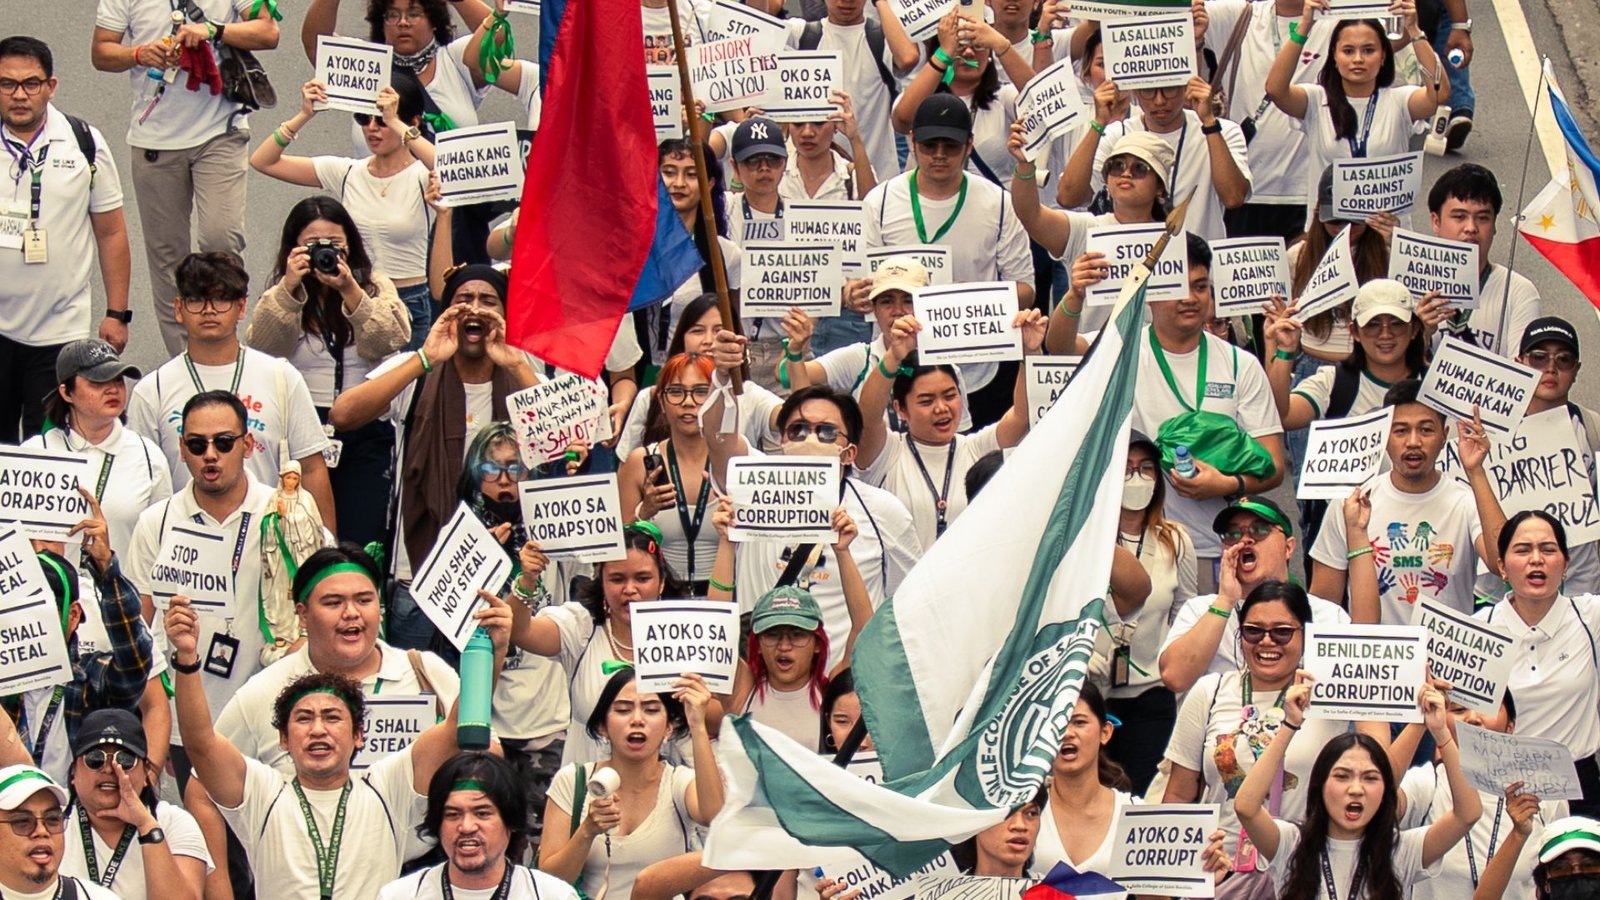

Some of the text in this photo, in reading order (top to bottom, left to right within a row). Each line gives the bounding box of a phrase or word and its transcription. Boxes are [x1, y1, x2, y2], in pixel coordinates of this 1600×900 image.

[900, 7, 926, 26] MGA
[1070, 4, 1101, 14] AKBAYAN
[1103, 8, 1127, 16] YOUTH
[1112, 26, 1184, 43] LASALLIANS
[1124, 42, 1174, 58] AGAINST
[327, 56, 381, 74] AYOKO SA
[692, 54, 778, 84] HAS ITS EYES
[1112, 56, 1189, 74] CORRUPTION
[328, 72, 379, 91] KURAKOT
[780, 68, 832, 82] OKO SA
[650, 89, 672, 101] ANG
[710, 78, 734, 102] ON
[784, 85, 830, 100] RAKOT
[1036, 81, 1066, 106] SHALL
[1037, 97, 1067, 121] STEAL
[437, 150, 474, 167] HUWAG
[477, 146, 510, 162] KANG
[440, 162, 509, 183] MAGNAKAW
[1342, 163, 1414, 181] LASALLIANS
[1353, 179, 1404, 196] AGAINST
[1340, 191, 1414, 210] CORRUPTION
[791, 222, 862, 236] HUWAG KANG
[750, 254, 829, 266] LASALLIANS
[1116, 243, 1154, 260] STOP
[1218, 249, 1280, 266] LASALLIANS
[1399, 242, 1468, 265] LASALLIANS
[762, 271, 818, 284] AGAINST
[1232, 265, 1276, 281] AGAINST
[1312, 265, 1340, 289] STEAL
[1407, 260, 1457, 280] AGAINST
[747, 286, 831, 300] CORRUPTION
[1220, 281, 1287, 300] CORRUPTION
[1394, 274, 1471, 295] CORRUPTION
[927, 303, 1006, 322] THOU SHALL
[933, 321, 1004, 339] NOT STEAL
[1436, 360, 1525, 402] HUWAG KANG
[514, 388, 541, 409] MGA
[585, 399, 596, 410] NA
[1435, 378, 1513, 417] MAGNAKAW
[1318, 430, 1382, 454] AYOKO SA
[1306, 452, 1381, 473] KORAPSYON
[0, 469, 80, 490] AYOKO SA
[738, 470, 827, 486] LASALLIANS
[0, 491, 88, 514] ORAPSYON
[751, 490, 814, 505] AGAINST
[533, 497, 606, 520] AYOKO SA
[736, 508, 830, 524] CORRUPTION
[528, 516, 618, 542] KORAPSYON
[0, 551, 23, 572] ALL
[171, 545, 198, 566] STOP
[1393, 556, 1423, 568] SMS
[151, 565, 227, 592] CORRUPTION
[428, 533, 478, 608] THOU SHALL
[1, 572, 27, 595] EAL
[441, 550, 487, 619] NOT STEAL
[1, 621, 47, 644] SHALL
[646, 623, 727, 642] AYOKO SA
[1421, 612, 1504, 658] LASALLIANS
[0, 642, 47, 665] STEAL
[637, 645, 733, 665] KORAPSYON
[1317, 642, 1415, 660] BENILDEANS
[1427, 638, 1487, 672] AGAINST
[1332, 664, 1399, 680] AGAINST
[1427, 657, 1496, 696] RRUPTION
[1314, 683, 1415, 701] CORRUPTION
[375, 719, 420, 733] SHALL
[1126, 827, 1204, 844] AYOKO SA
[1125, 849, 1198, 866] CORRUPT
[102, 860, 119, 887] NILDE
